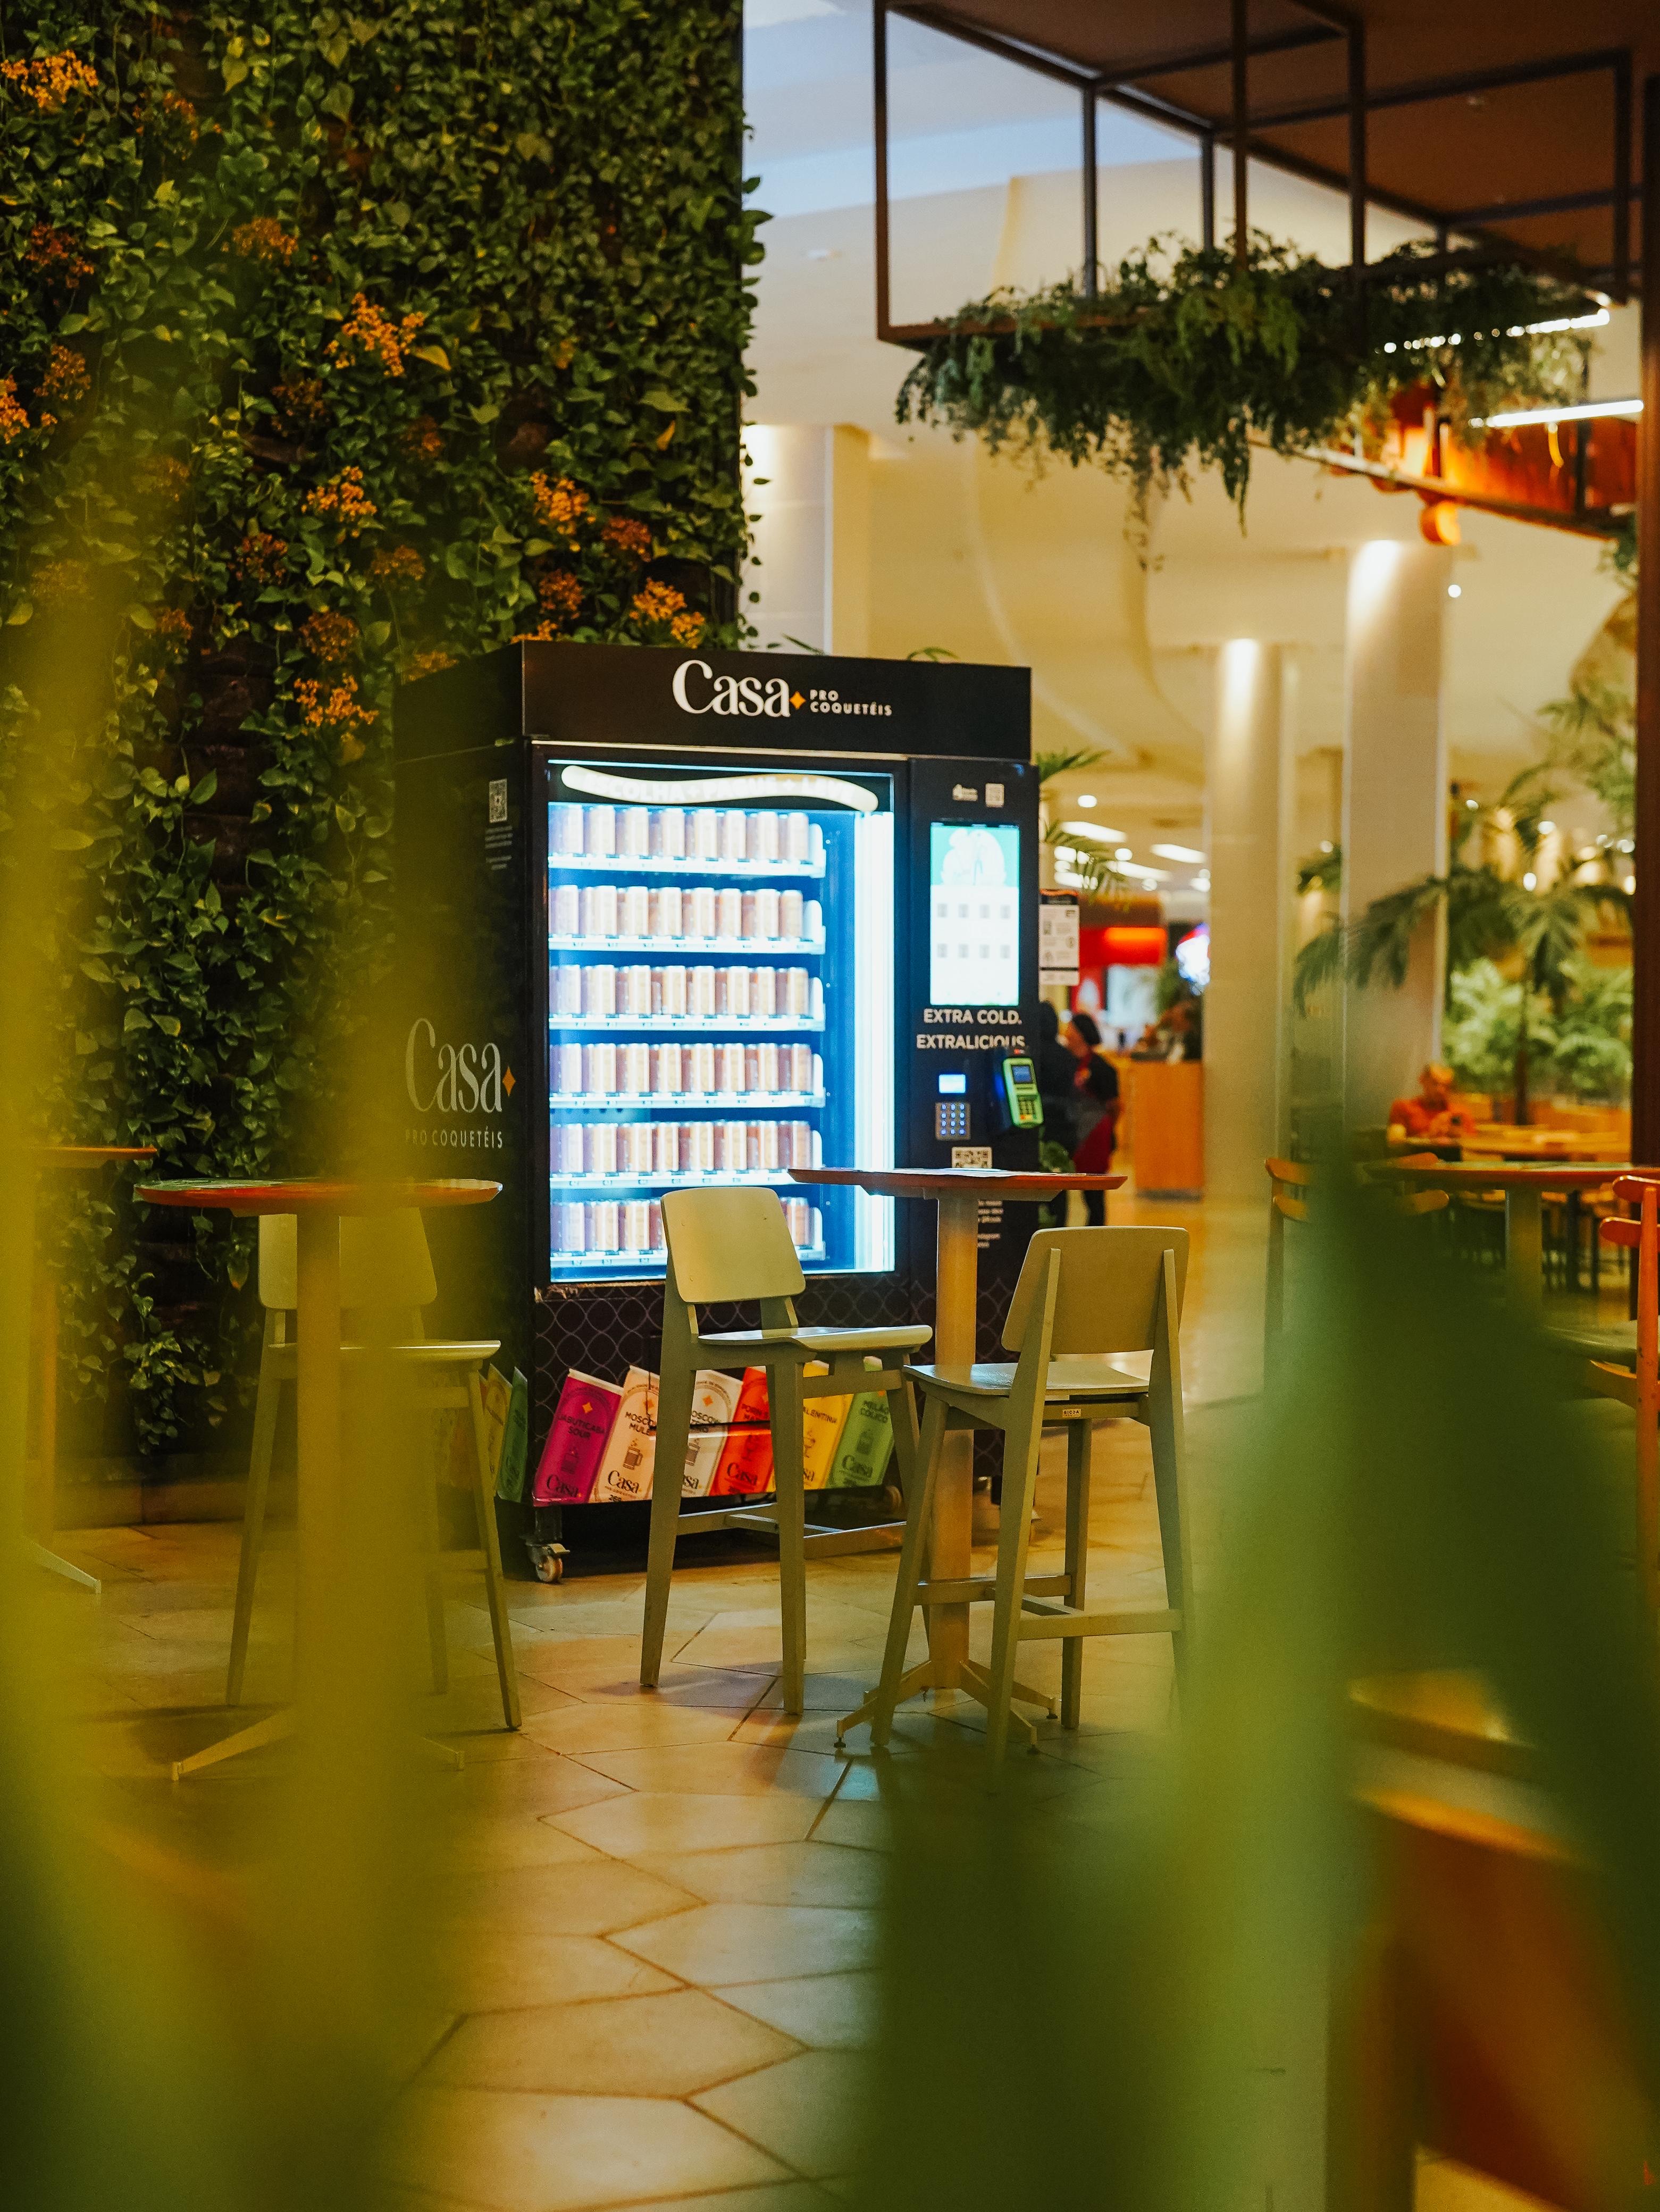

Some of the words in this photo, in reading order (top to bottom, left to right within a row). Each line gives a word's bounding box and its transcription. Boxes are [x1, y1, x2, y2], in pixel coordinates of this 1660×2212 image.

[672, 659, 791, 717] Casa
[810, 689, 839, 701] PRO
[810, 701, 892, 716] COQUETÉIS
[583, 772, 686, 801] ESCOLHA
[923, 1008, 974, 1024] EXTRA
[977, 1009, 1022, 1025] COLD.
[406, 1017, 502, 1113] Casa
[406, 1128, 427, 1145] PRO
[432, 1125, 503, 1149] COQUETÉIS
[726, 1462, 758, 1486] Casa
[842, 1454, 874, 1478] Casa
[546, 1474, 580, 1498] Casa
[607, 1470, 640, 1494] Casa
